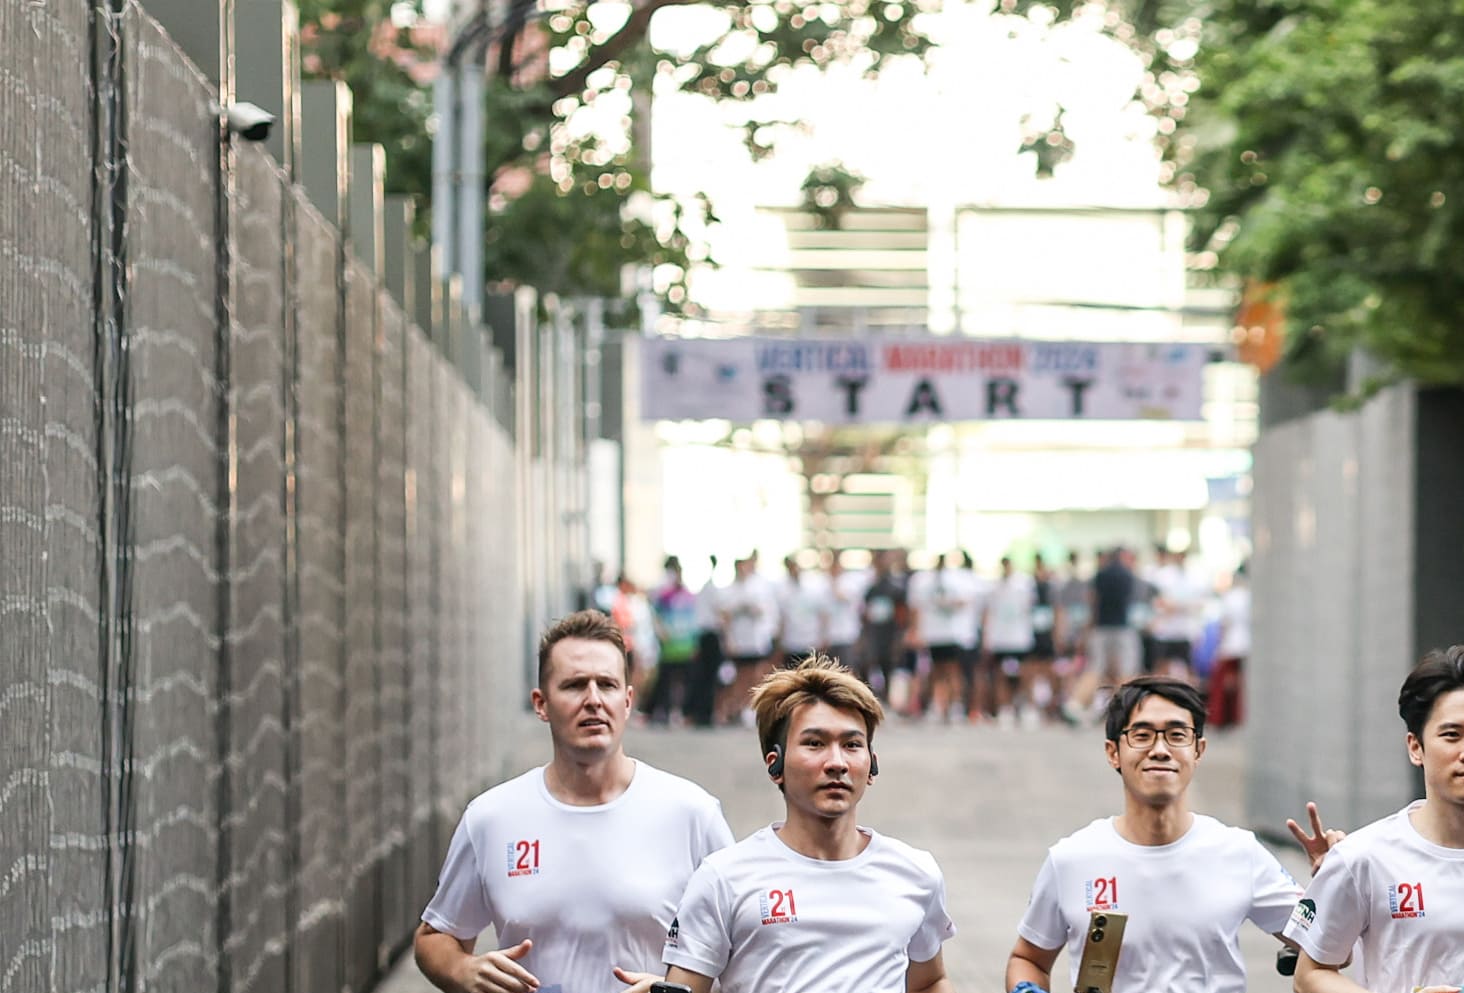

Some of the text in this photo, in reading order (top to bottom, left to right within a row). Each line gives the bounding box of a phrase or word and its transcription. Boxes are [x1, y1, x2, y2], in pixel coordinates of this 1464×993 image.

[761, 374, 1096, 416] START
[516, 839, 540, 869] 21
[769, 889, 796, 917] 21
[1094, 876, 1117, 905] 21
[1398, 882, 1424, 912] 21
